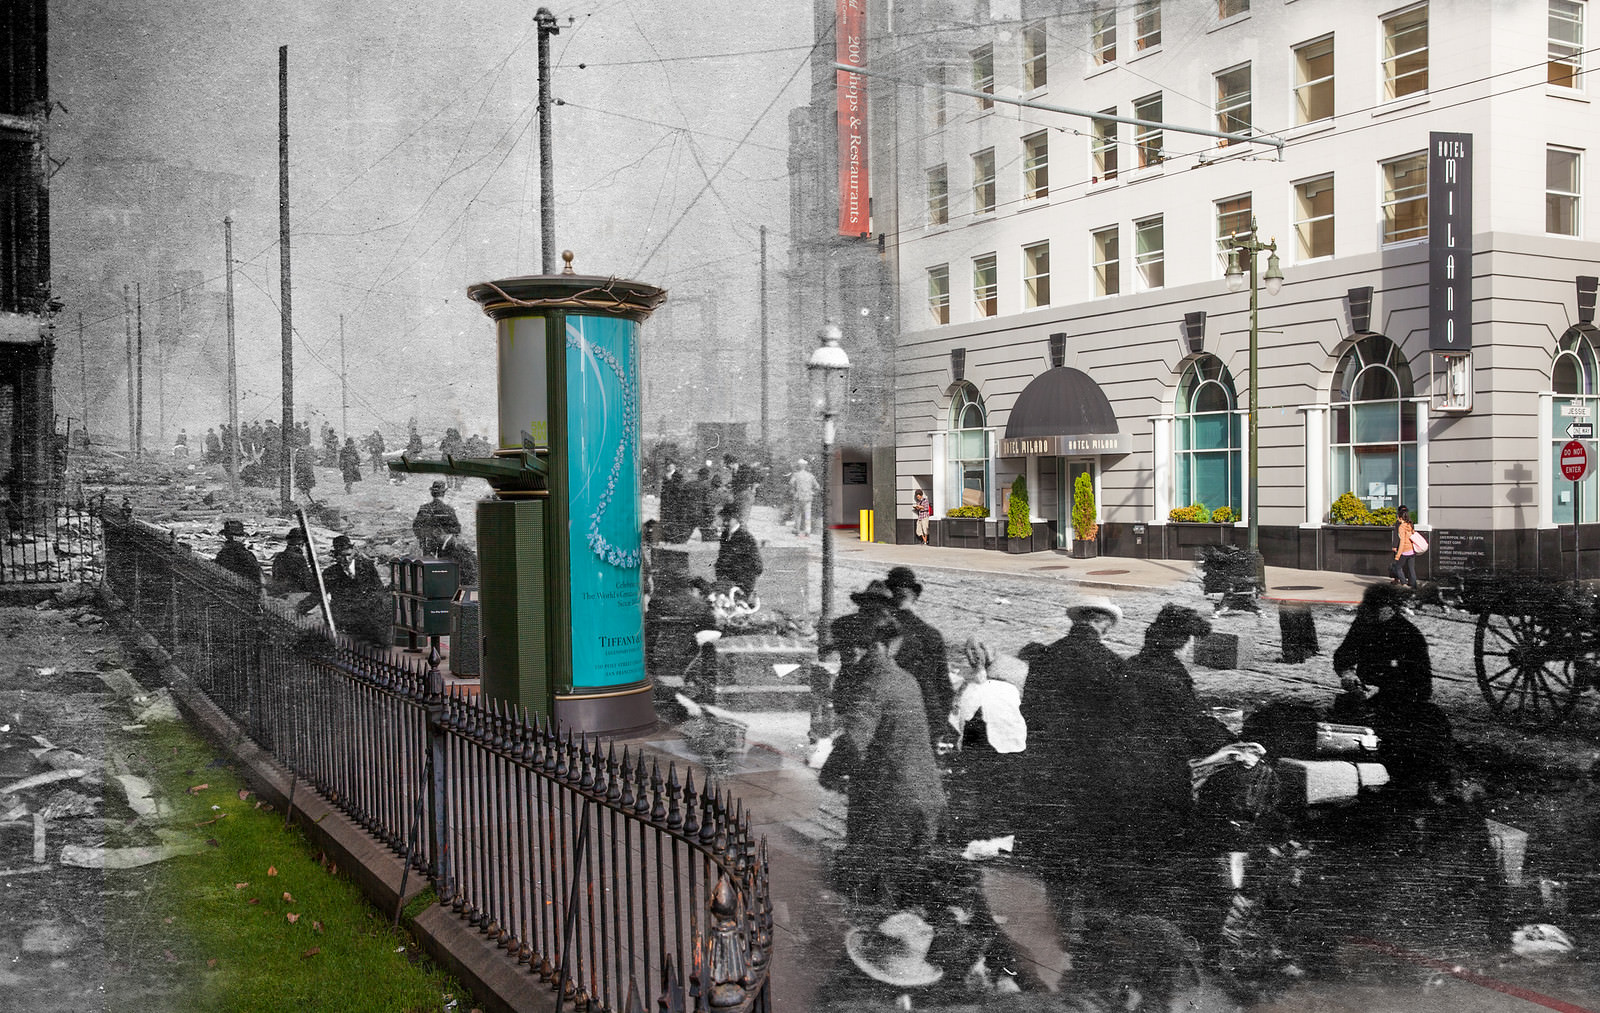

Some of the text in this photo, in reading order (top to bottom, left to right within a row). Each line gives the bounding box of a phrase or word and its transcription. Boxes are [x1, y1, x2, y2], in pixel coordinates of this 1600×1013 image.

[848, 36, 860, 63] 200
[850, 116, 861, 130] &
[1438, 141, 1464, 158] HOTEL
[850, 134, 862, 223] Restaurants
[1004, 441, 1019, 454] HOTEL
[1068, 440, 1089, 450] HOTEL
[1565, 466, 1581, 474] ENTER
[583, 592, 595, 600] The
[598, 636, 635, 647] TIFFANY
